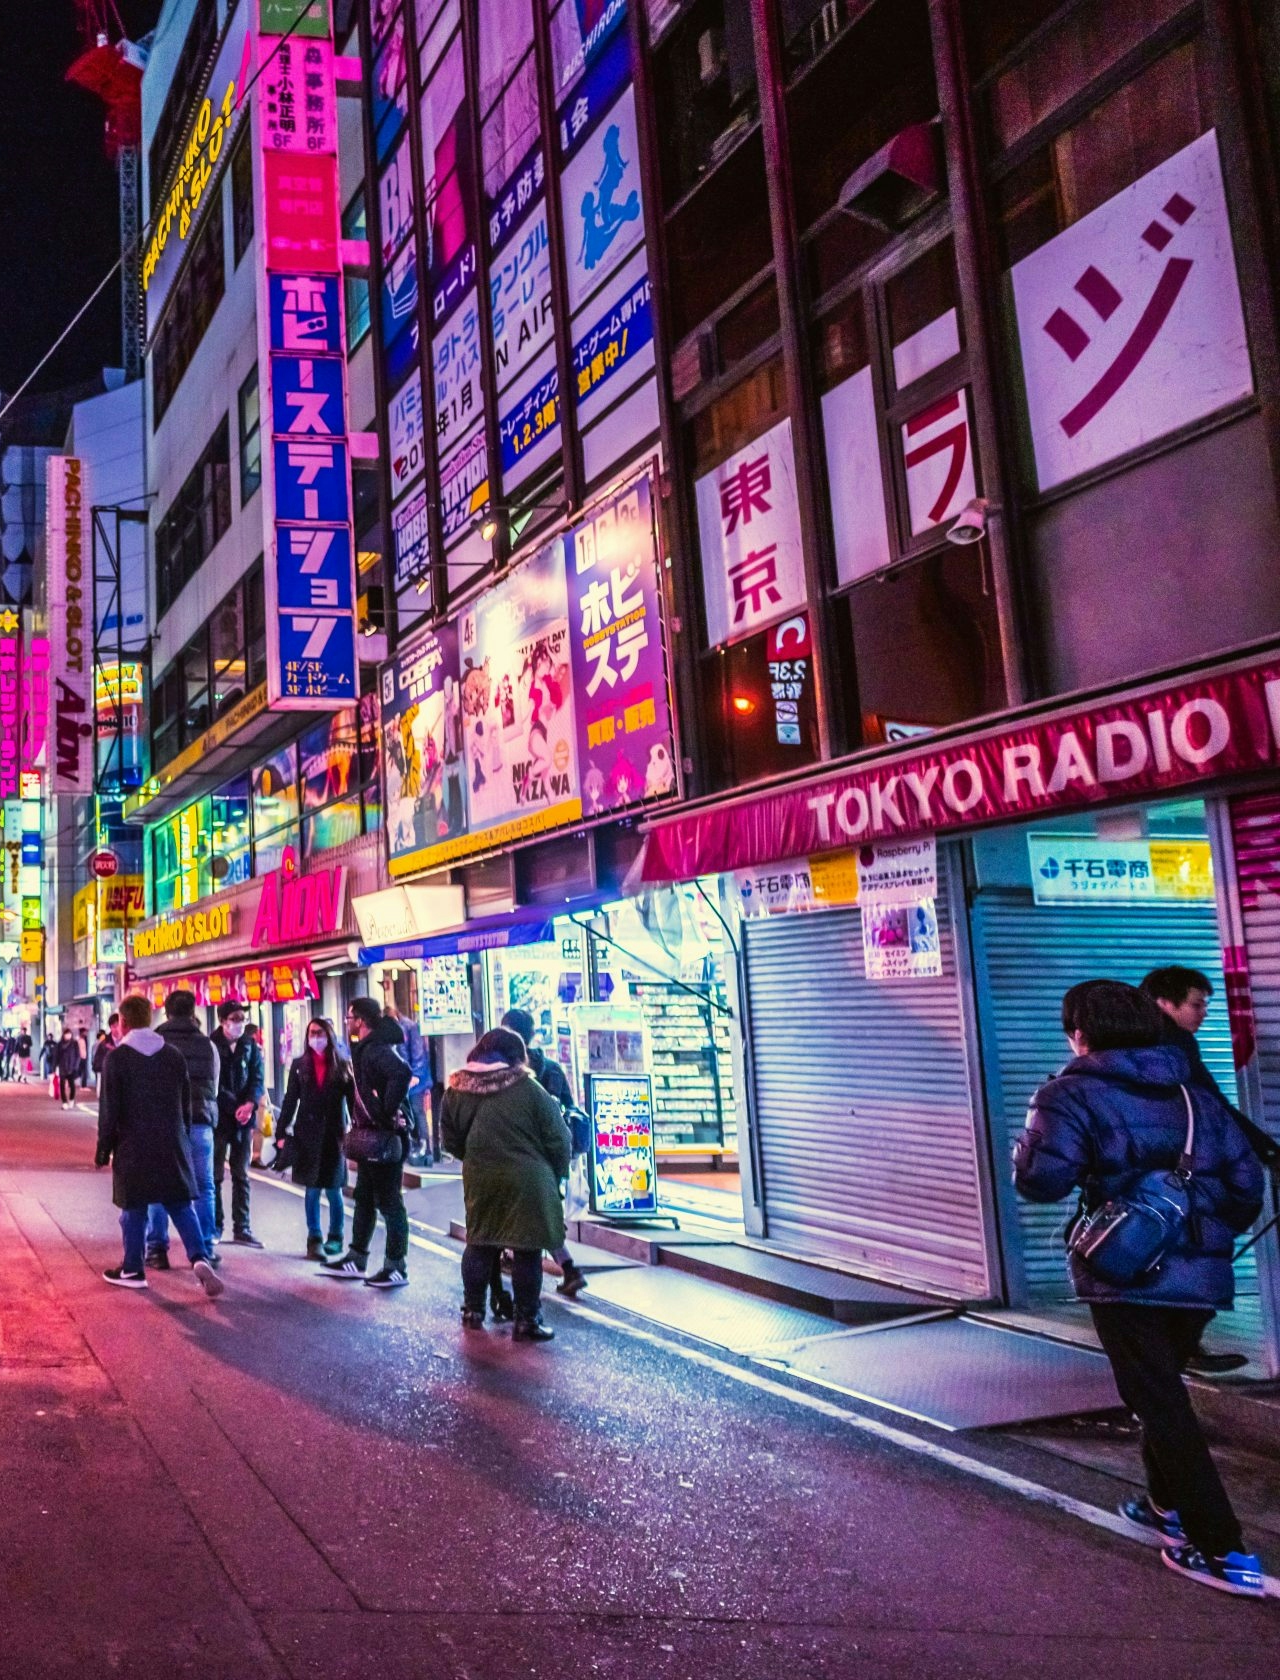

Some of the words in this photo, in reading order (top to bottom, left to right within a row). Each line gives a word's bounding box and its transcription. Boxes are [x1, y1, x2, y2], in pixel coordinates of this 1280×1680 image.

[143, 97, 211, 291] PACHINKO
[64, 459, 82, 581] PACHINKO
[720, 454, 782, 623] 東京
[904, 391, 967, 523] ラ
[579, 553, 644, 637] ホビ
[585, 618, 649, 699] ステ
[807, 758, 985, 842] TOKYO
[1001, 697, 1230, 802] RADIO
[876, 844, 921, 859] Raspberry
[1063, 858, 1150, 879] 千石電商
